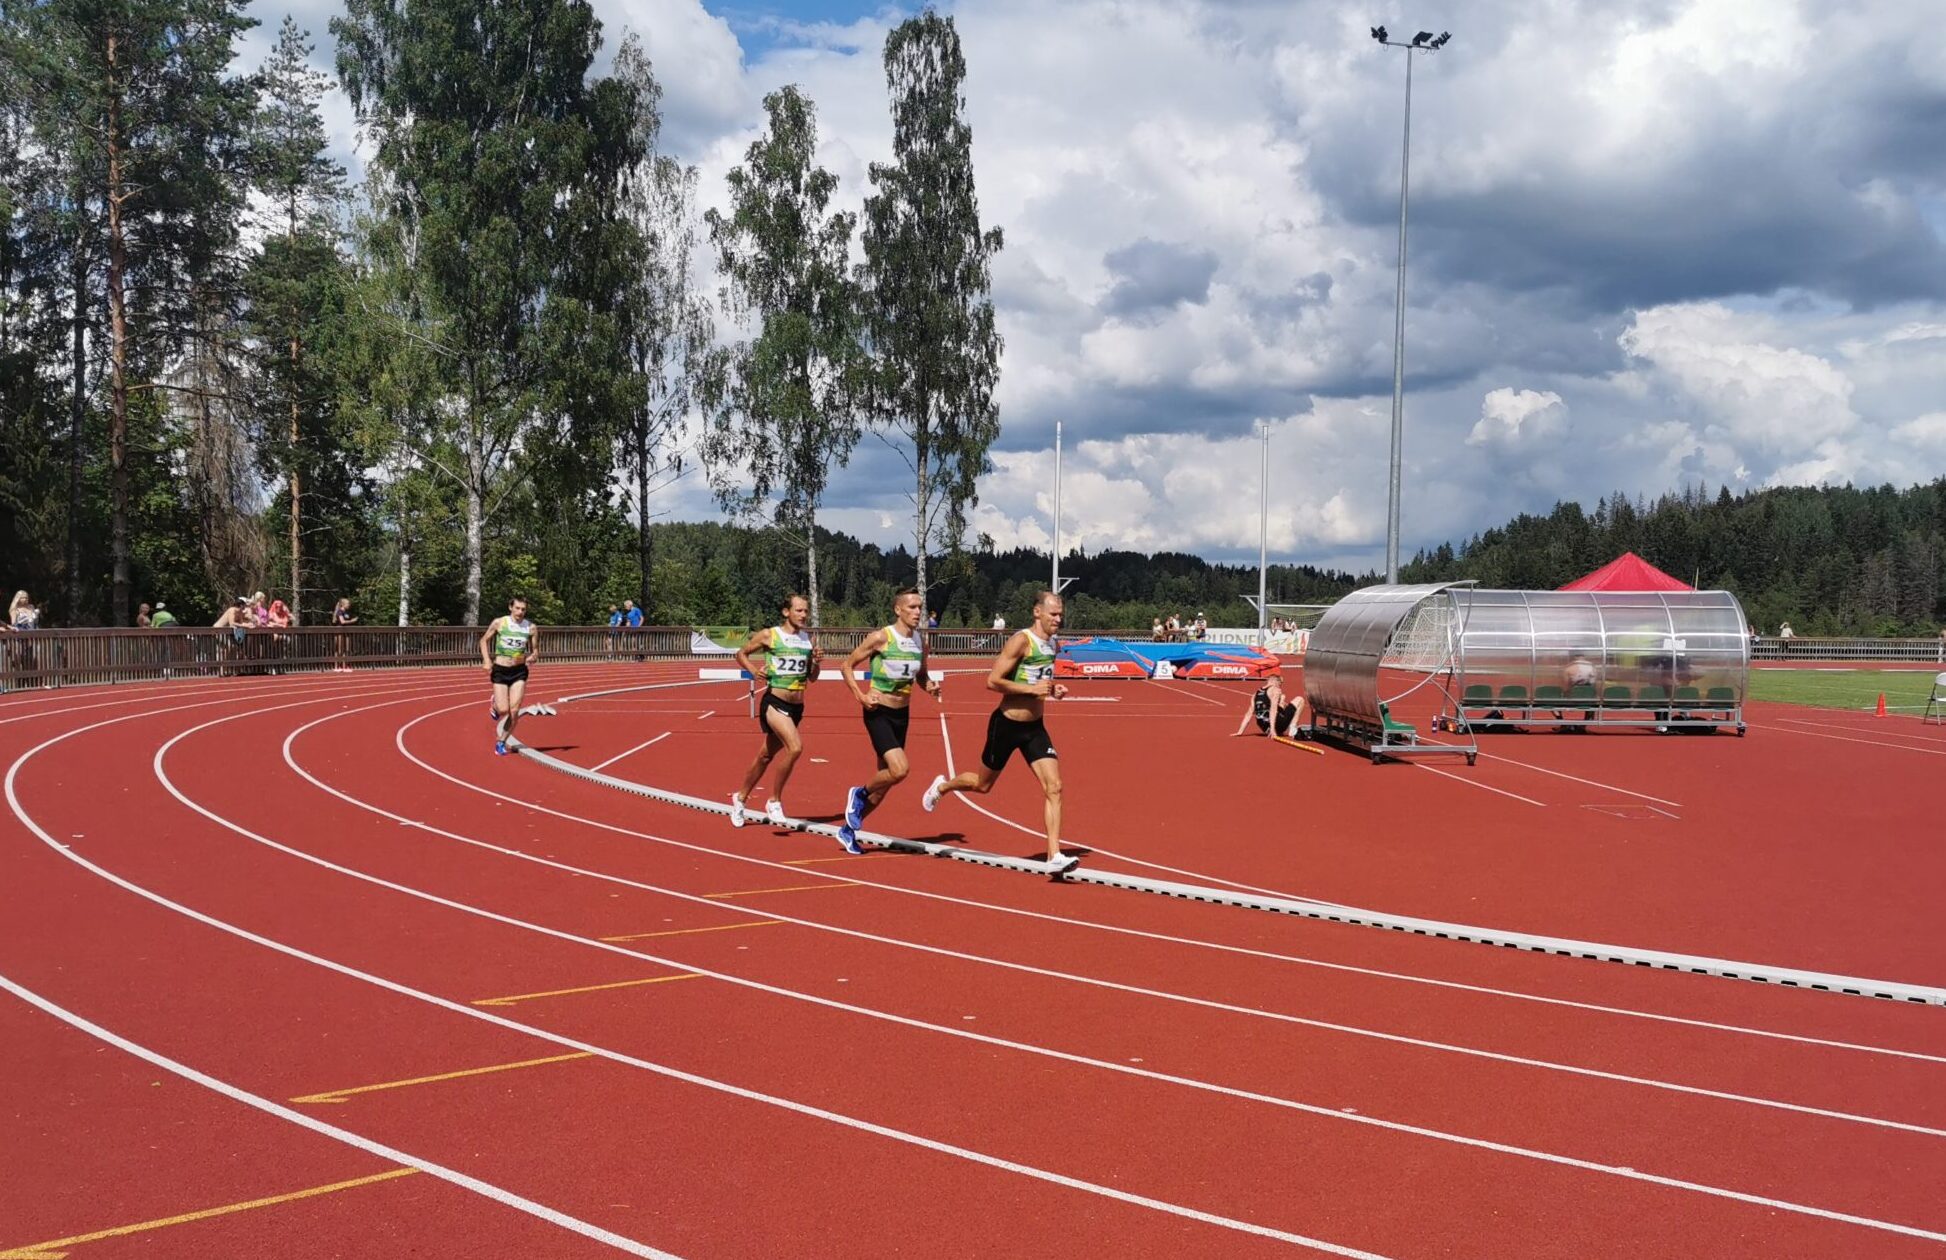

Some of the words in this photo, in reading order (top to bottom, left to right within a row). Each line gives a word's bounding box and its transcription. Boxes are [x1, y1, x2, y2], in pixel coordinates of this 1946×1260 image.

[777, 658, 806, 673] 229
[901, 664, 910, 676] 1
[1083, 664, 1119, 674] DIMA
[1160, 664, 1169, 675] 5
[1212, 665, 1249, 675] DIMA
